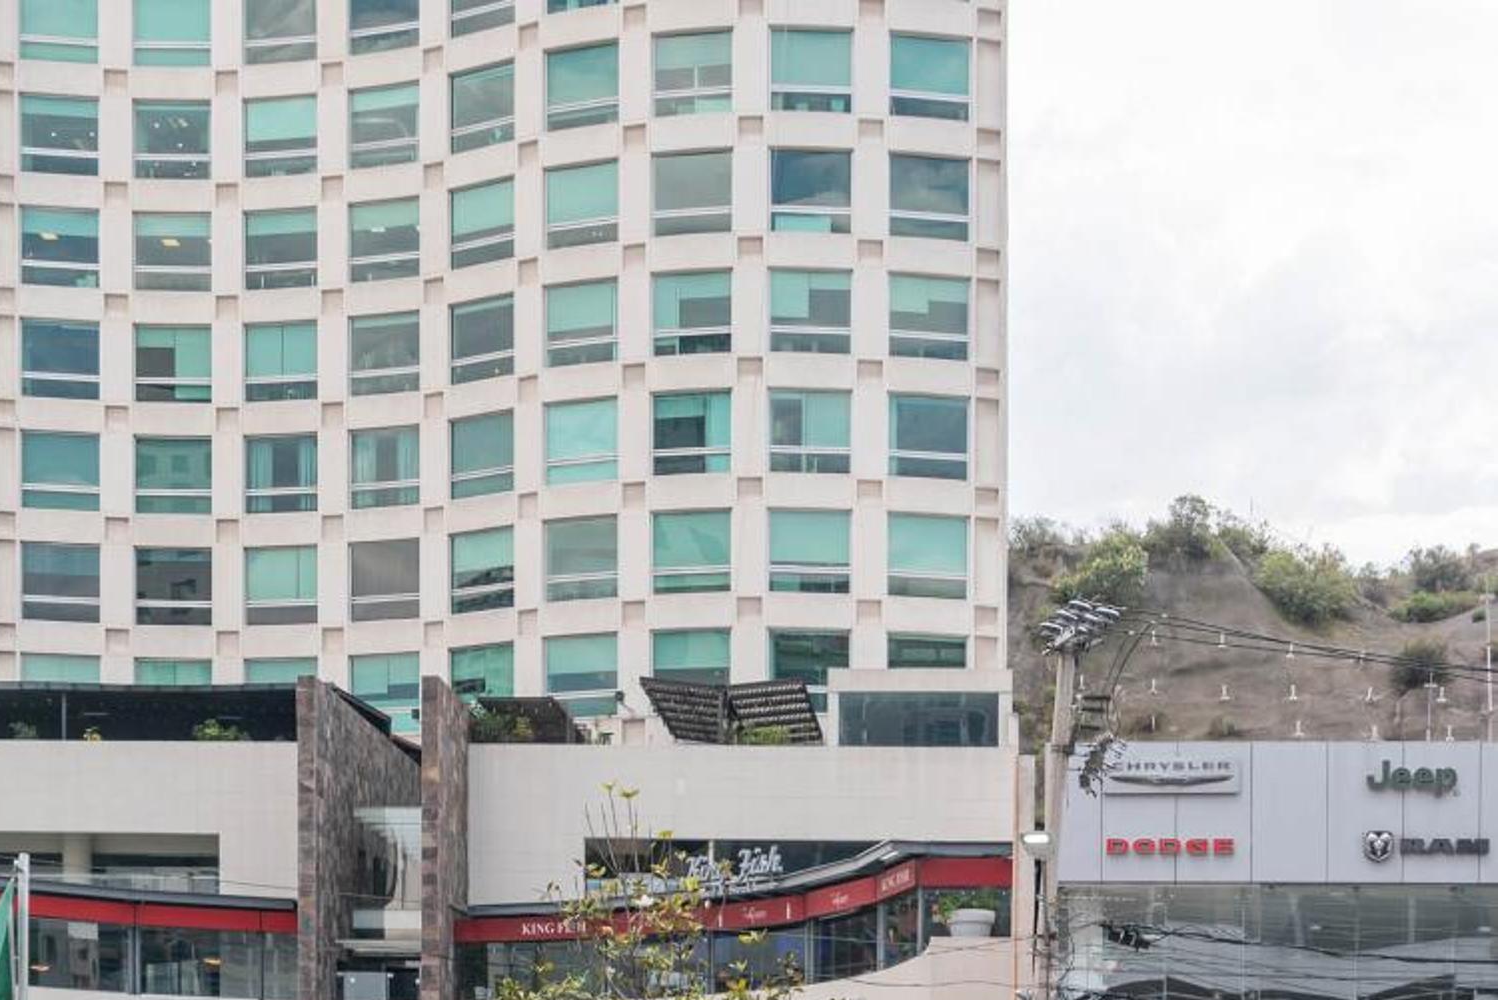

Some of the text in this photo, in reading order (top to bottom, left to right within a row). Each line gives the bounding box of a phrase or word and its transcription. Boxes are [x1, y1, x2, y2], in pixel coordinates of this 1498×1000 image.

[1366, 760, 1458, 798] Jeep
[1106, 838, 1235, 855] DODGE
[1400, 838, 1489, 855] RAM
[522, 921, 587, 935] KING FIH
